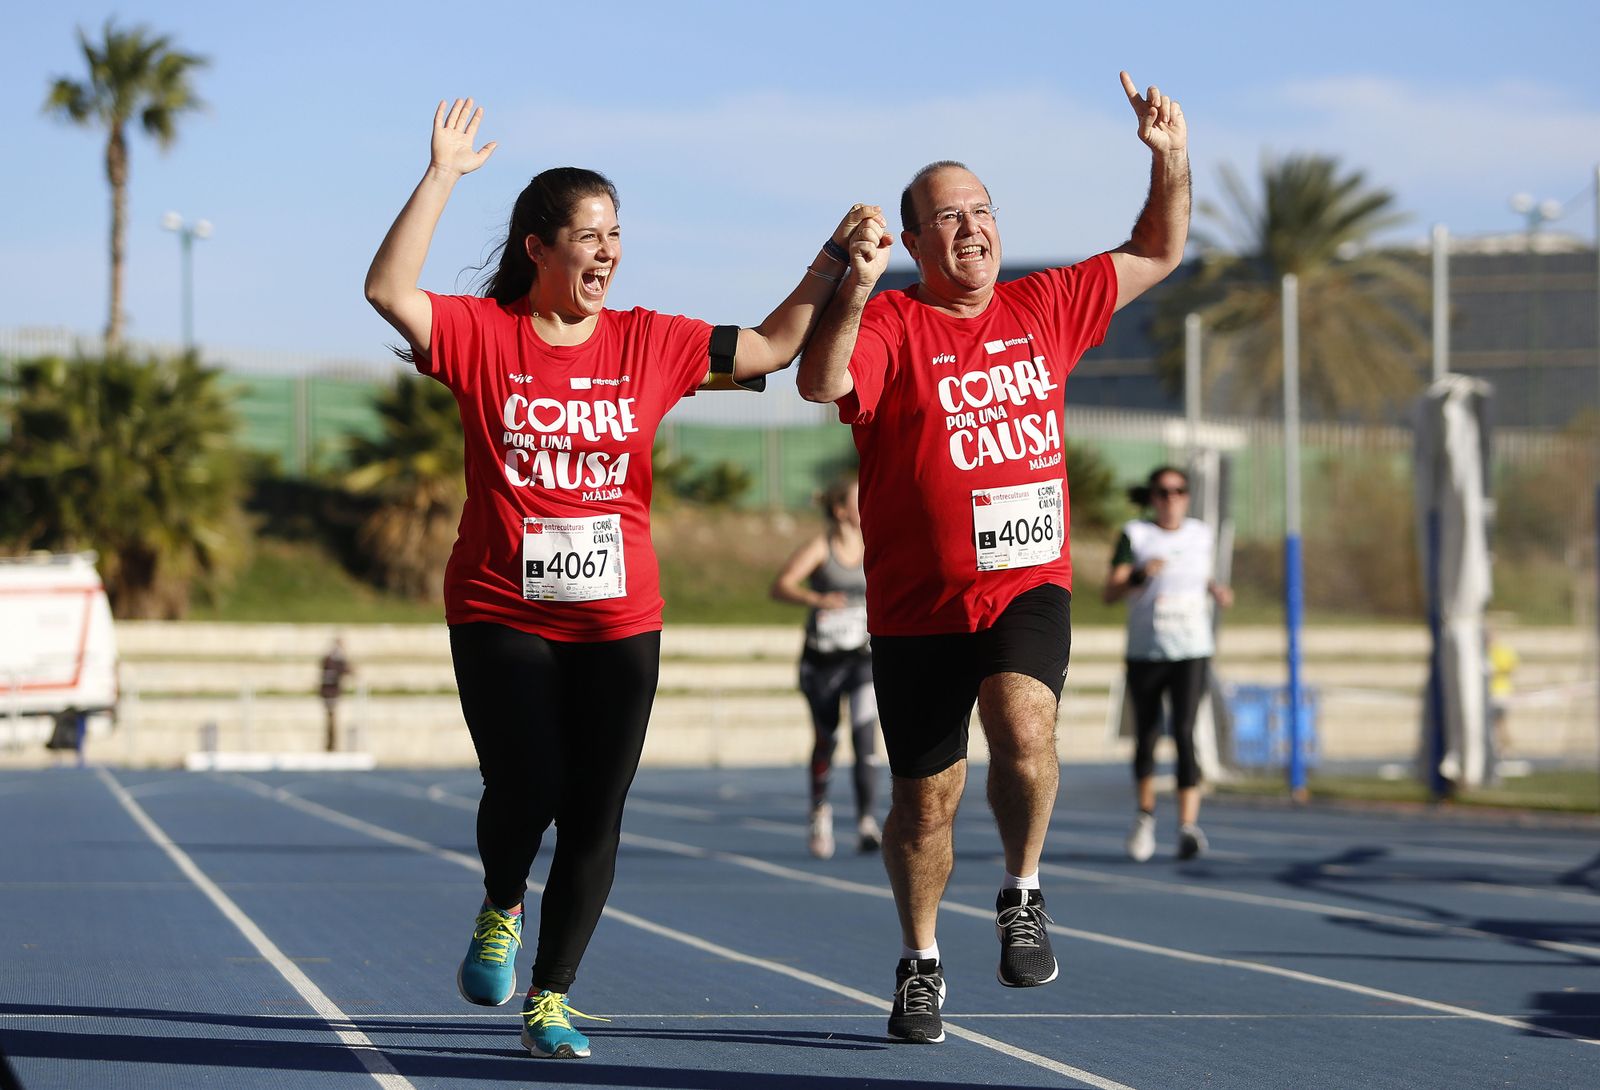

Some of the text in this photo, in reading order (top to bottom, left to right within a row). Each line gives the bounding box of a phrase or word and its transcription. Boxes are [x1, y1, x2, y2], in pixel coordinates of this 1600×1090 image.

[938, 355, 1058, 413] CORRE
[503, 393, 639, 442] CORRE
[945, 404, 1008, 430] POR UNA
[503, 431, 572, 451] POR UNA
[949, 409, 1060, 471] CAUSA
[504, 448, 630, 489] CAUSA
[992, 491, 1030, 501] entreculturas
[544, 523, 585, 531] entreculturas
[998, 514, 1054, 547] 4068
[546, 549, 608, 580] 4067
